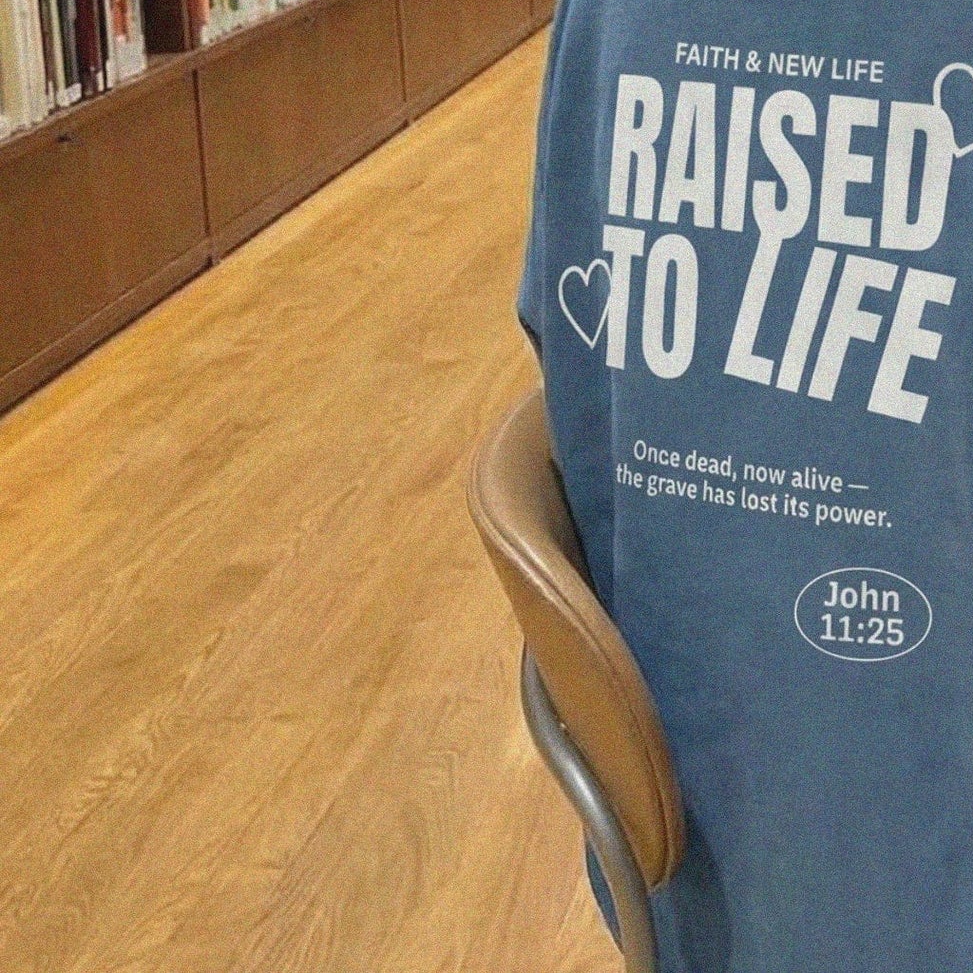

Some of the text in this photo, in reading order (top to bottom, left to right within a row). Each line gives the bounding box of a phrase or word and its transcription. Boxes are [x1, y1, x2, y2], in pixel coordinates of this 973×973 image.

[675, 41, 884, 83] FAITH & NEW LIFE
[608, 74, 954, 251] RAISED
[602, 225, 956, 424] TO LIFE
[633, 440, 681, 468] Once
[685, 450, 737, 481] dead,
[743, 464, 786, 485] now
[791, 467, 843, 493] alive
[616, 464, 892, 527] the grave has lost its power.
[823, 580, 900, 612] John
[820, 613, 904, 646] 11:25
